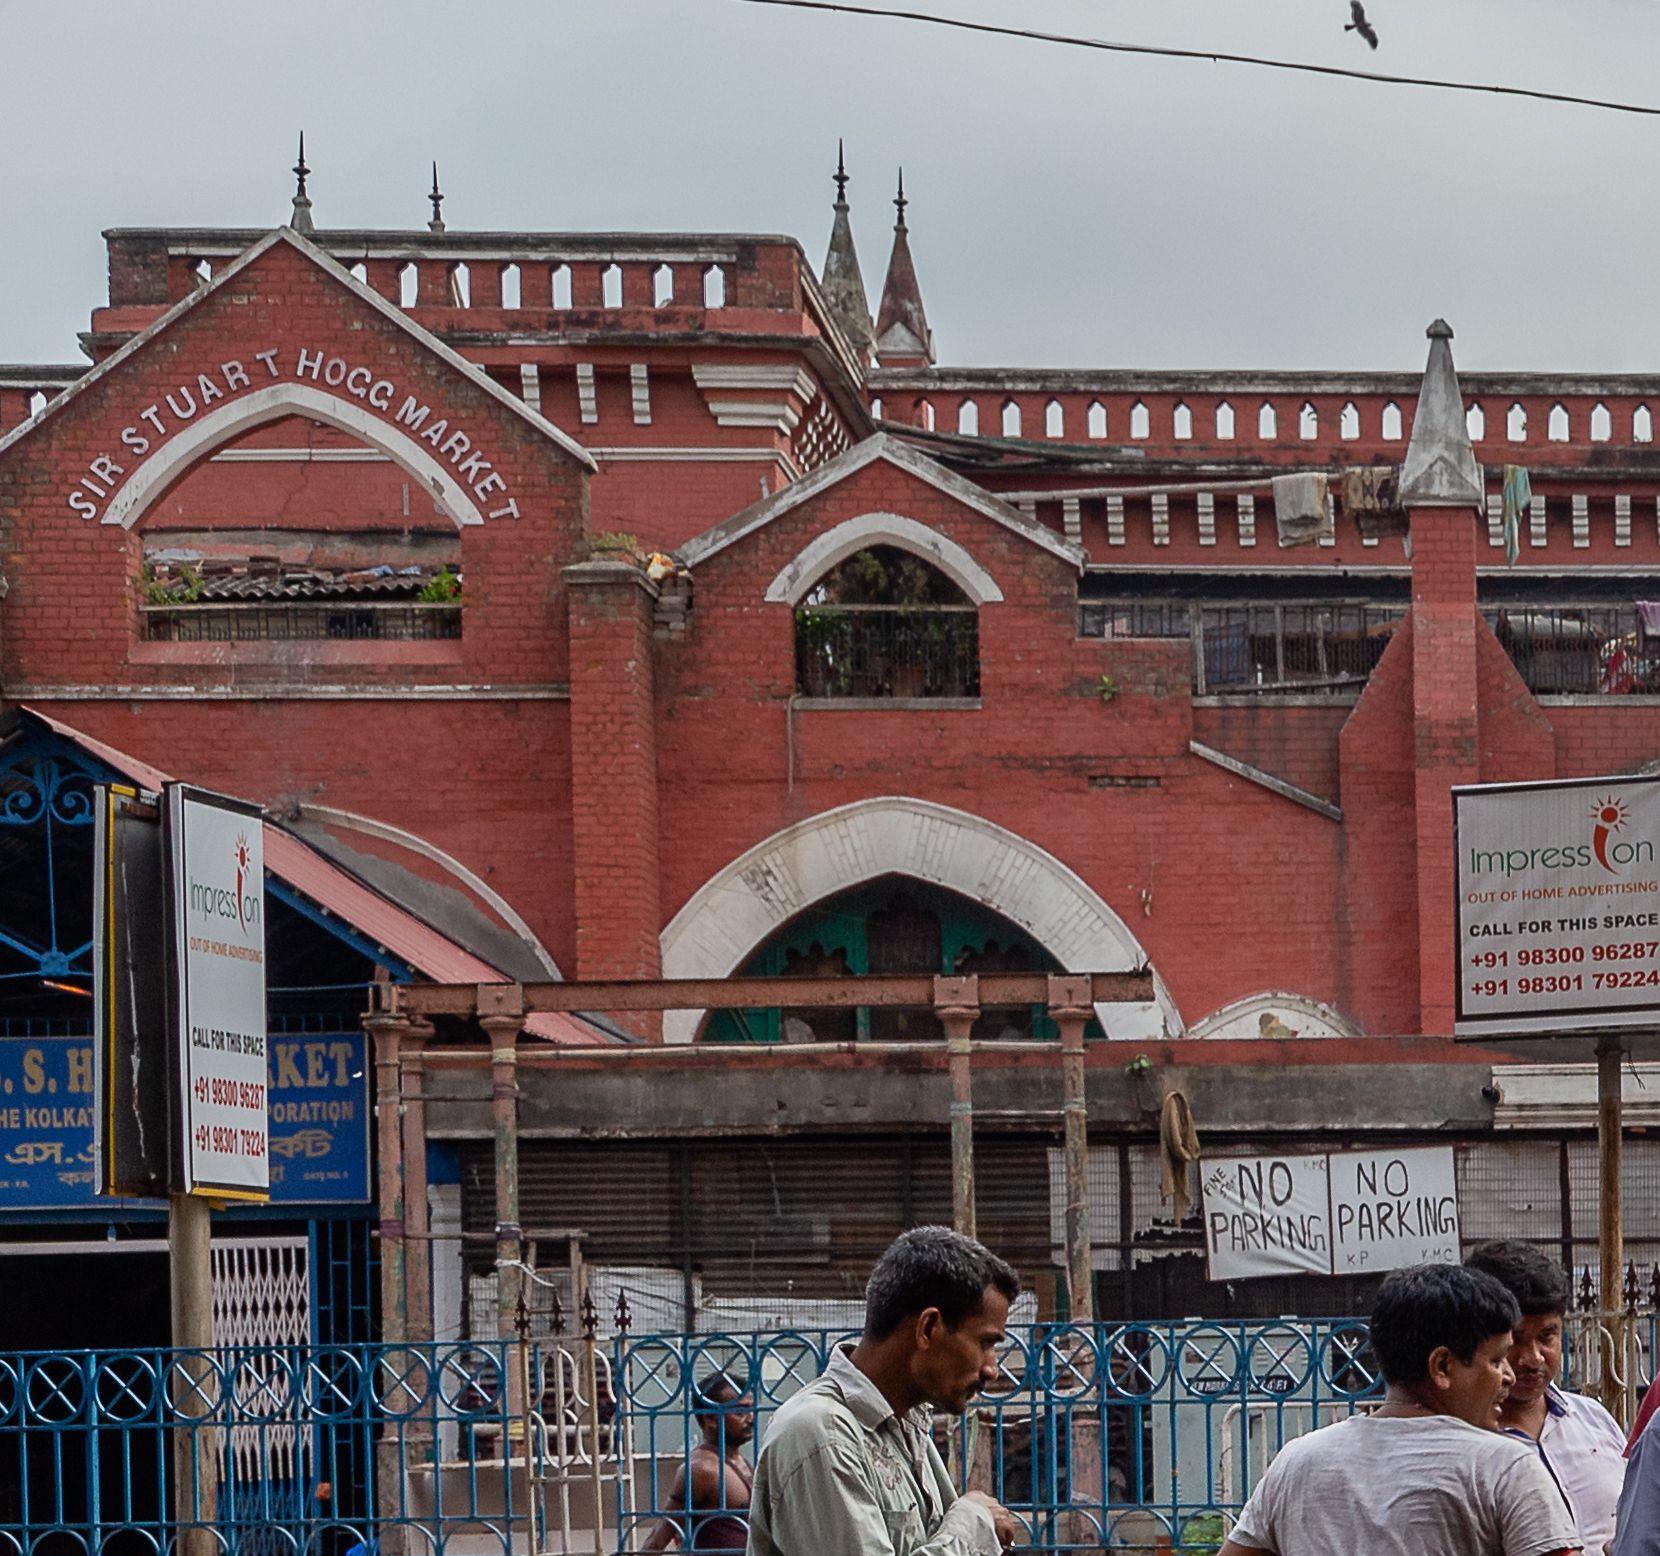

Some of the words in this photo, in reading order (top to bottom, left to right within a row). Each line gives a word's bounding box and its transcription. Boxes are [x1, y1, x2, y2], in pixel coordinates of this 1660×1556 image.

[69, 455, 124, 520] SIR
[121, 348, 279, 455] STUART
[296, 348, 394, 411] HOGG
[395, 395, 520, 520] MARKET
[1471, 824, 1654, 878] Impression
[190, 867, 260, 937] Impression
[1468, 891, 1495, 904] OUT
[1500, 890, 1518, 902] OF
[1522, 888, 1564, 900] HOME
[1568, 881, 1658, 897] ADVERTISING
[1470, 924, 1512, 938] CALL
[1518, 920, 1552, 934] FOR
[1557, 917, 1598, 931] THIS
[1603, 913, 1659, 929] SPACE
[1471, 951, 1509, 968] +91
[1518, 946, 1584, 966] 98300
[1592, 942, 1659, 962] 96287
[1471, 979, 1509, 996] +91
[1518, 974, 1583, 995] 98301
[1592, 970, 1660, 990] 79224
[193, 1027, 209, 1048] CALL
[211, 1029, 225, 1050] FOR
[226, 1031, 242, 1053] THIS
[243, 1034, 264, 1057] SPACE
[194, 1076, 209, 1104] +91
[212, 1079, 237, 1107] 98300
[240, 1082, 264, 1111] 96287
[195, 1130, 210, 1152] +91
[213, 1130, 238, 1154] 98301
[240, 1131, 265, 1157] 79224
[1237, 1159, 1294, 1210] NO
[1357, 1159, 1409, 1197] NO
[1210, 1211, 1326, 1253] PARKING
[1338, 1196, 1456, 1244] PARKING
